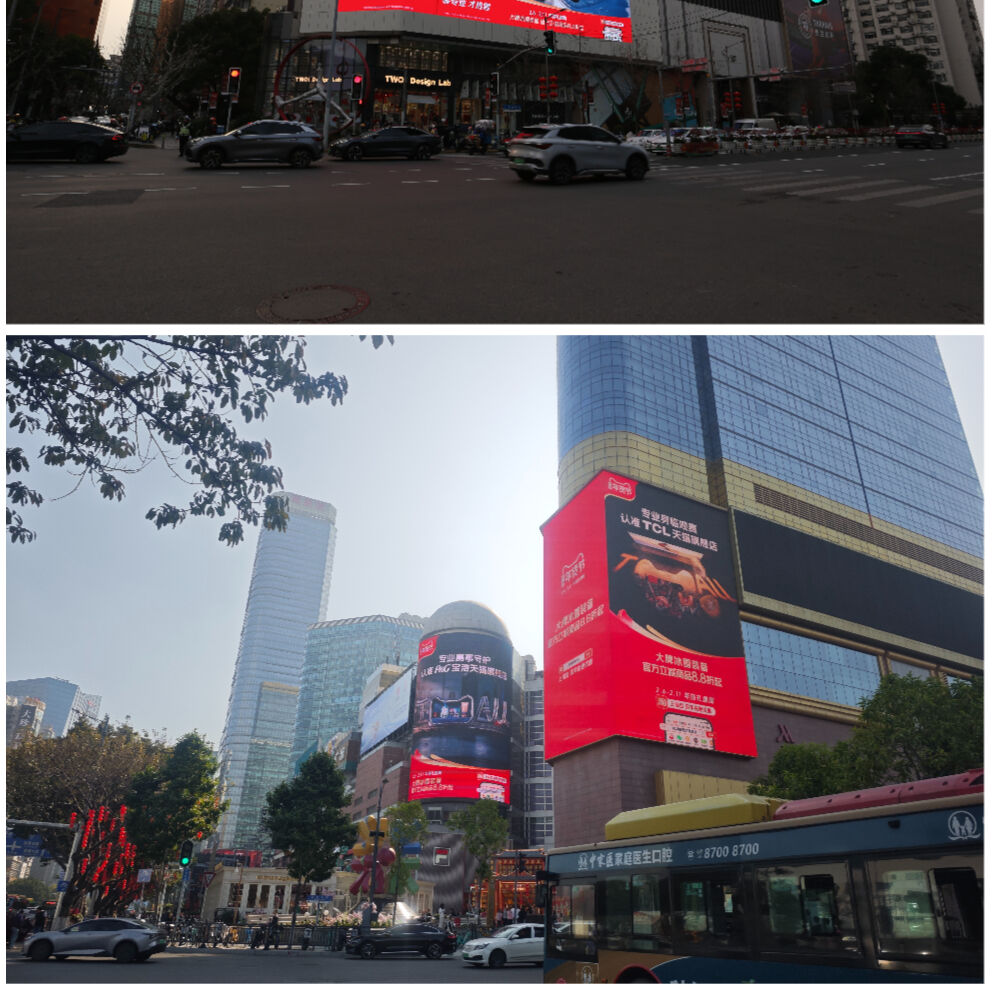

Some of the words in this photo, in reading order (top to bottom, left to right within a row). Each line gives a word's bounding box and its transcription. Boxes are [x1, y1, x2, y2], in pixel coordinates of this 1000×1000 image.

[410, 76, 436, 88] Design
[438, 78, 452, 87] Lab
[620, 512, 641, 528] 认准
[644, 519, 671, 537] TCL
[672, 529, 718, 552] 天猫旗舰店
[655, 652, 709, 673] 大牌冰雪装备
[641, 662, 724, 688] 官方立减商品8.8折起
[704, 846, 729, 859] 8700
[732, 842, 759, 856] 8700
